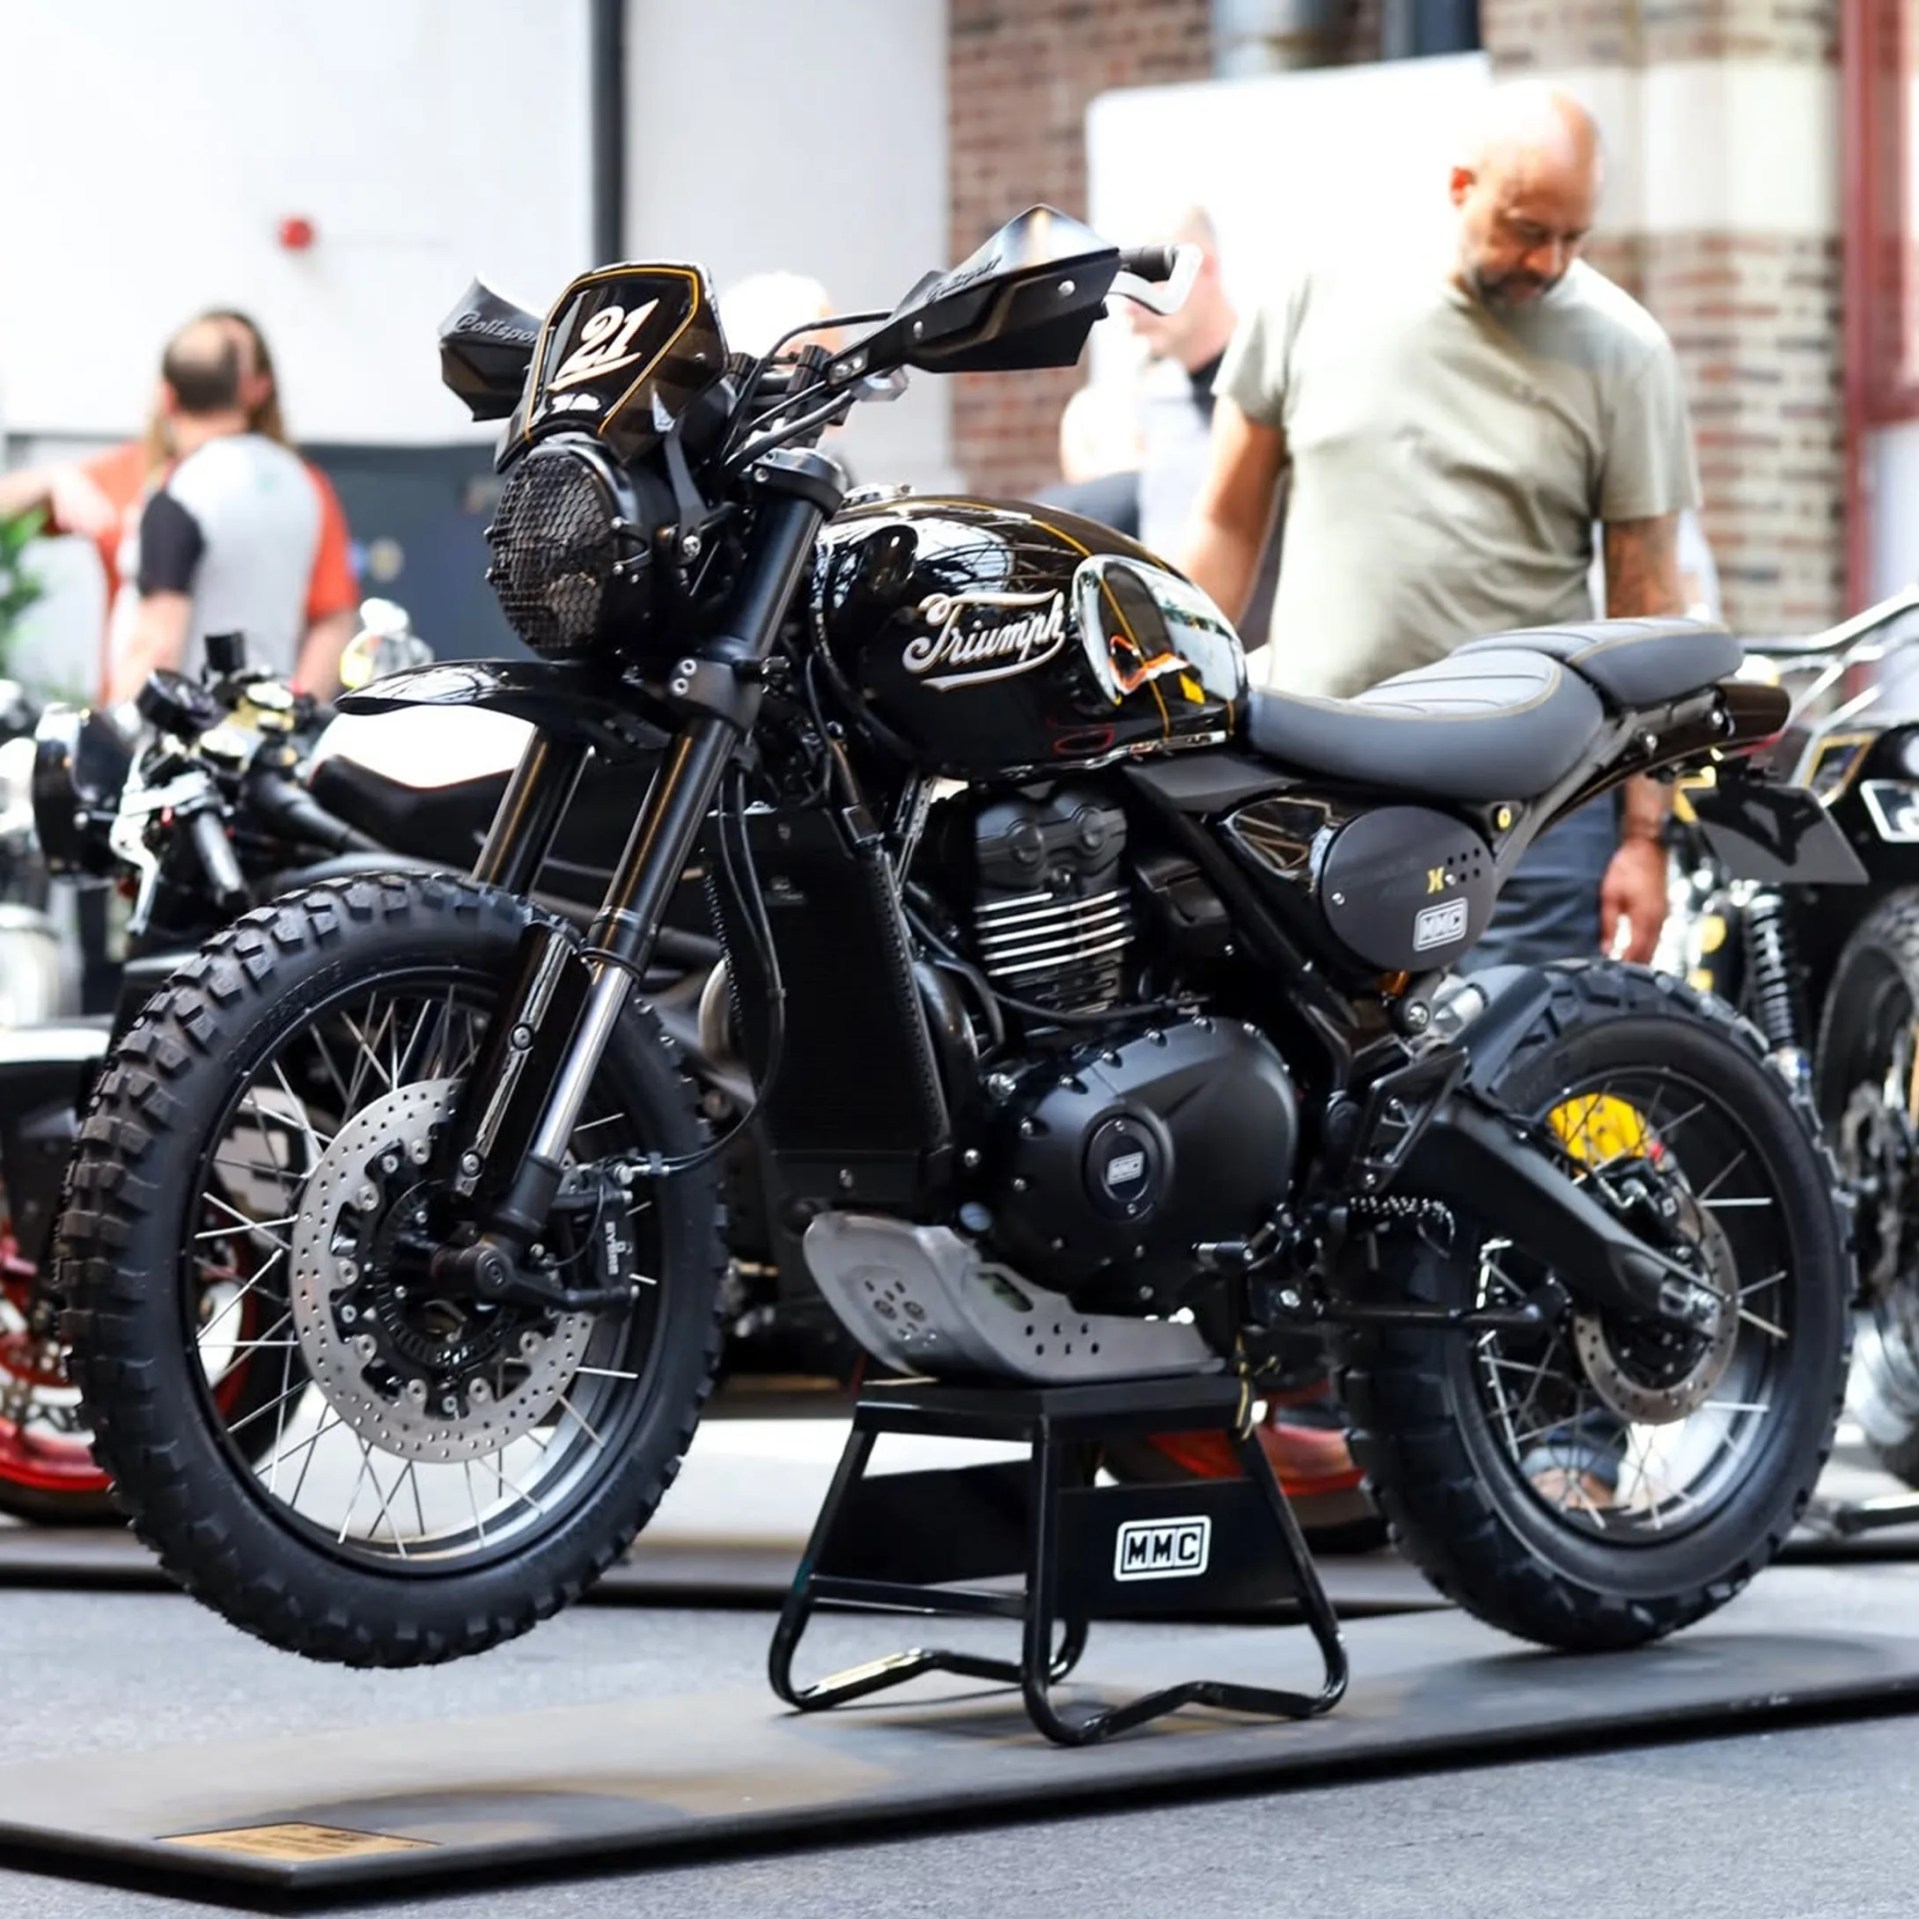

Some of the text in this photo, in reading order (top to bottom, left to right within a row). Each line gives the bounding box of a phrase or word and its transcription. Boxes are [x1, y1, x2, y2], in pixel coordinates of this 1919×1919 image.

[548, 298, 660, 391] 21
[902, 587, 1066, 692] Triumph
[1127, 1532, 1198, 1565] MMC
